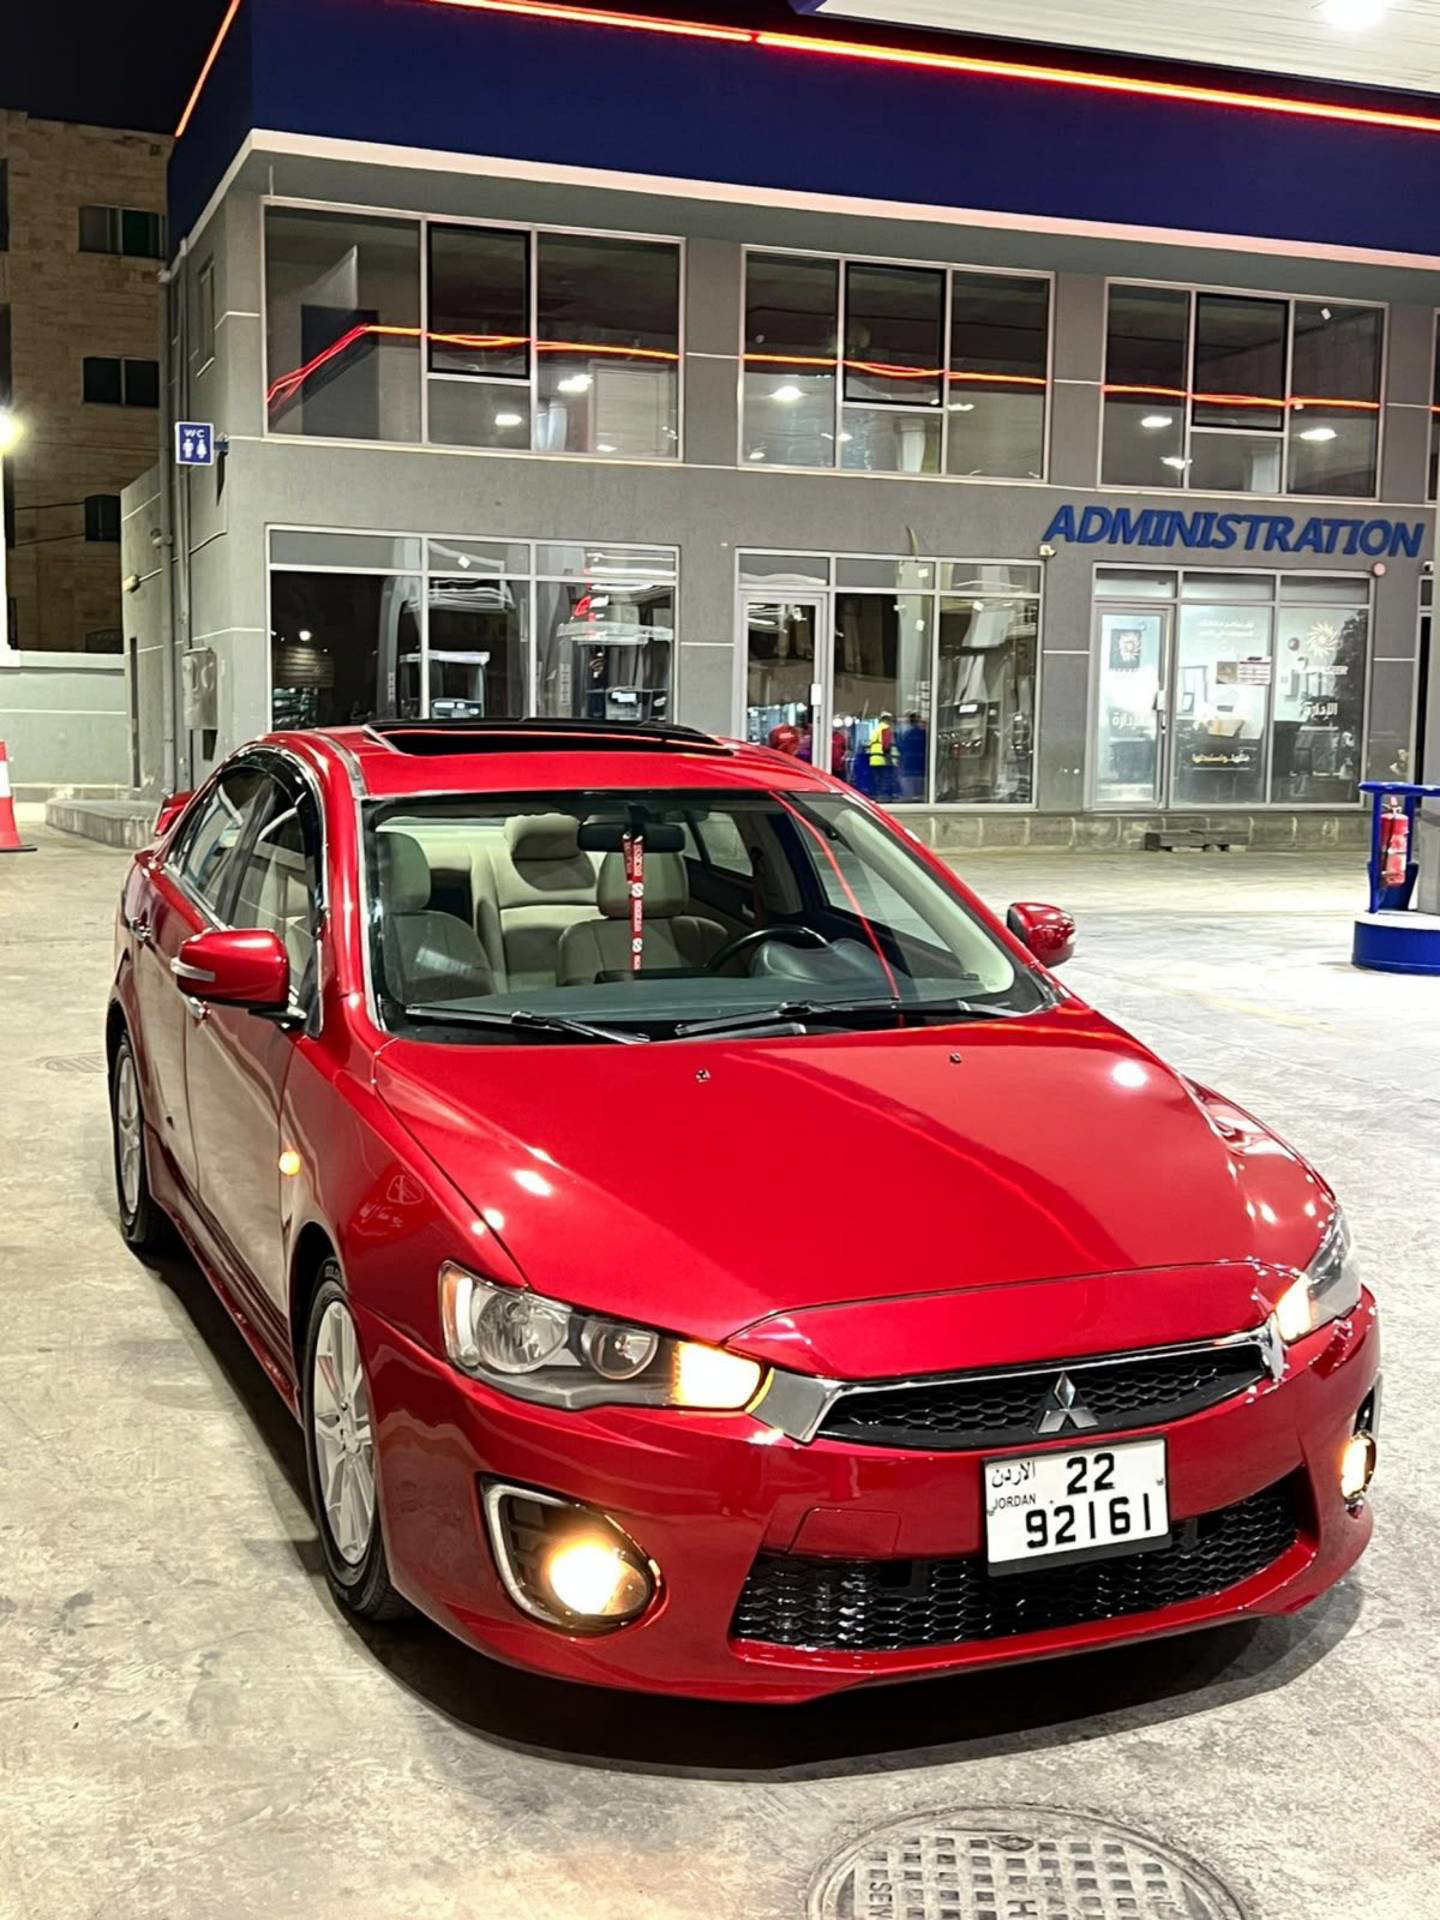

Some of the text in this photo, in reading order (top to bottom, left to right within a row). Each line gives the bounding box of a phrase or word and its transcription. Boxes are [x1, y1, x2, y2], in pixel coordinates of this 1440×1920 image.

[184, 429, 206, 438] WC
[1041, 504, 1425, 557] ADMINISTRATION
[1066, 1452, 1115, 1497] 22
[993, 1493, 1037, 1511] JORDAN
[1025, 1492, 1152, 1549] 92161
